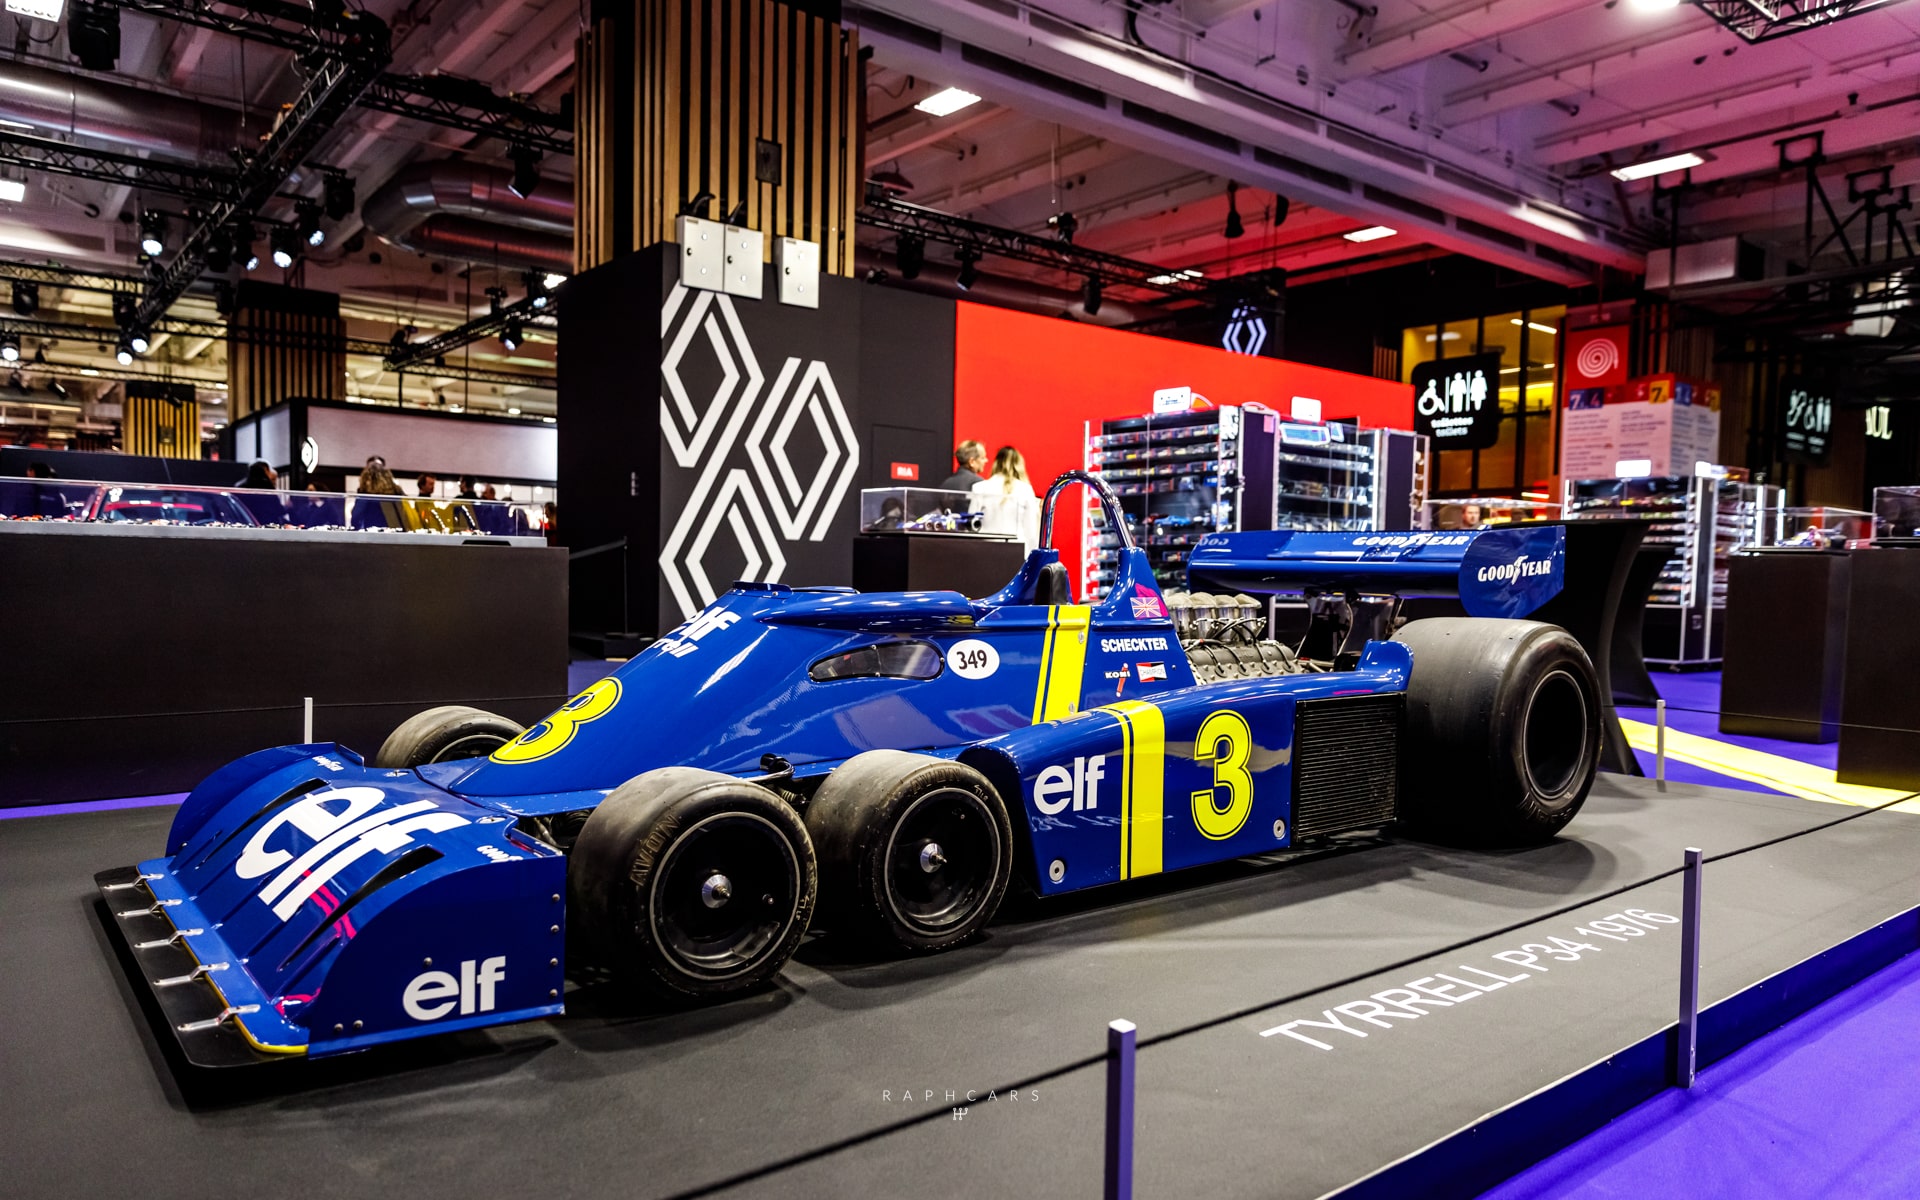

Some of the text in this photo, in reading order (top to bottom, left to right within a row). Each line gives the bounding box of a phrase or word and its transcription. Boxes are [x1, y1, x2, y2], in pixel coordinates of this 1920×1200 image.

[956, 649, 988, 670] 349
[1100, 637, 1168, 653] SCHECKTER
[1105, 670, 1131, 679] KONI
[1033, 755, 1105, 815] elf
[1190, 708, 1254, 841] 3
[234, 786, 473, 923] elf
[630, 814, 681, 886] AVON
[403, 955, 507, 1021] elf
[1259, 908, 1680, 1051] TYRRELL P34 1976
